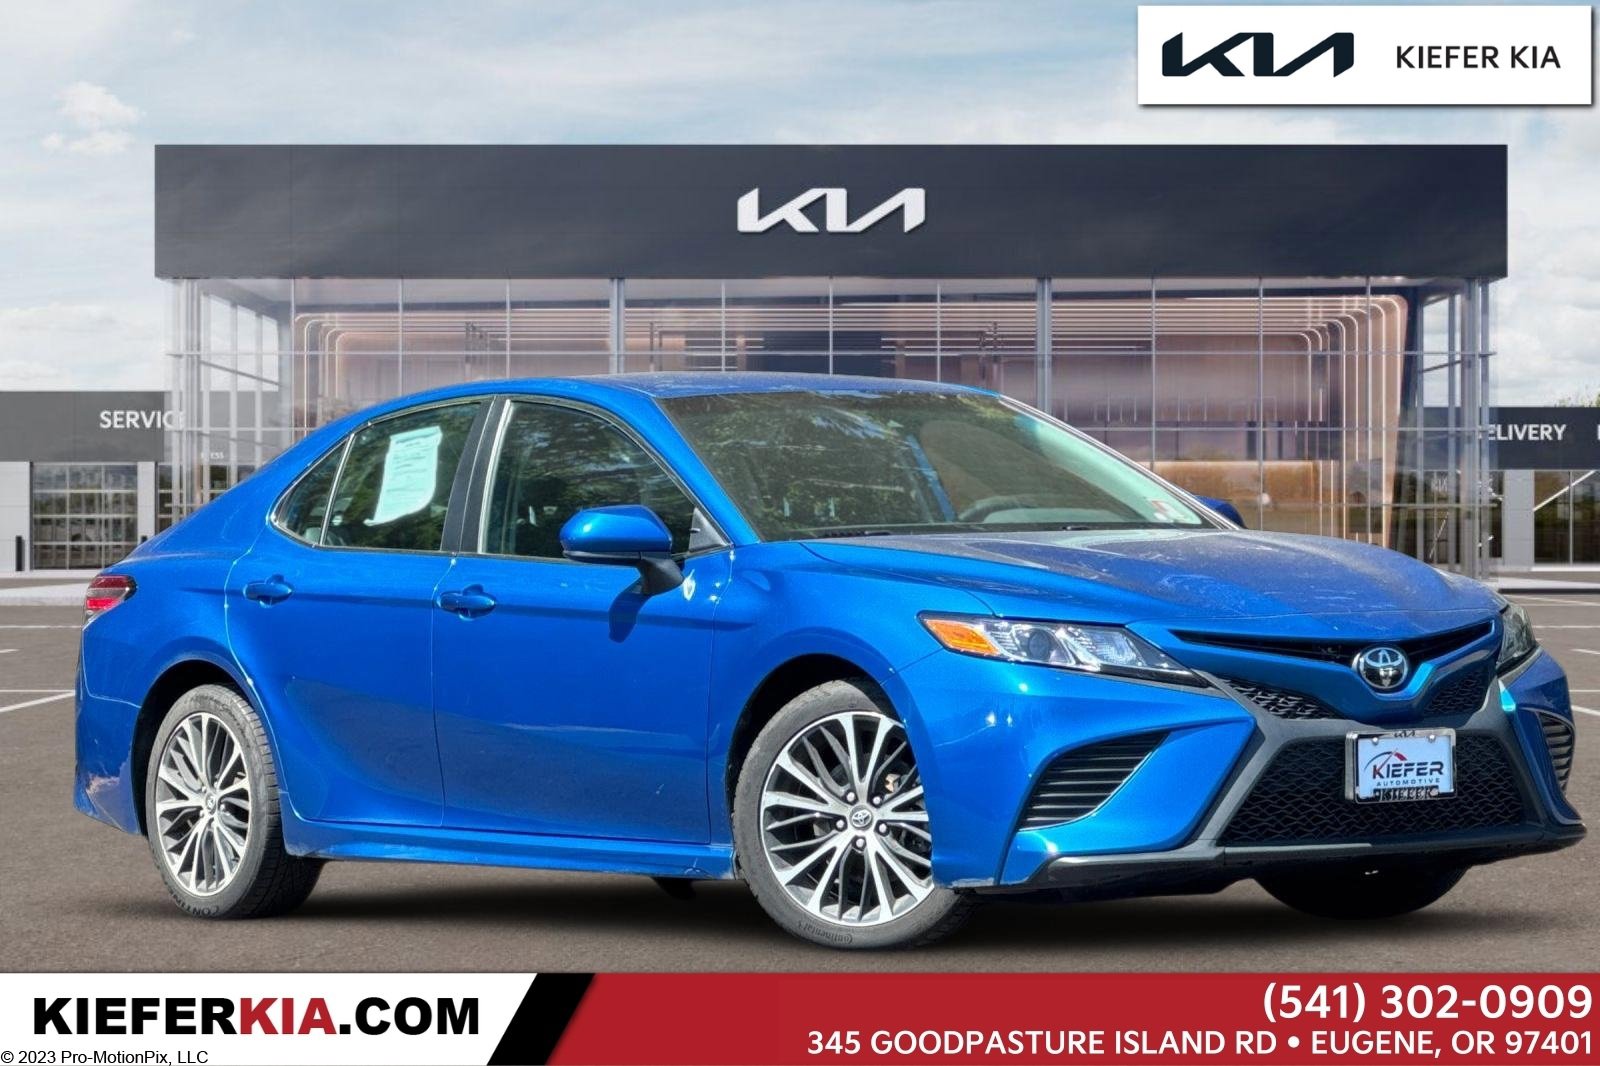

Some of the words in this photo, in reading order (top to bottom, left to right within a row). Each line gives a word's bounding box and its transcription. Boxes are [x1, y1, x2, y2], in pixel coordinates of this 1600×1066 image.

[737, 188, 925, 232] KIA
[1479, 423, 1567, 441] ELIVERY
[1373, 761, 1444, 779] KIEFER
[1376, 778, 1440, 787] AUTOMOTIVE
